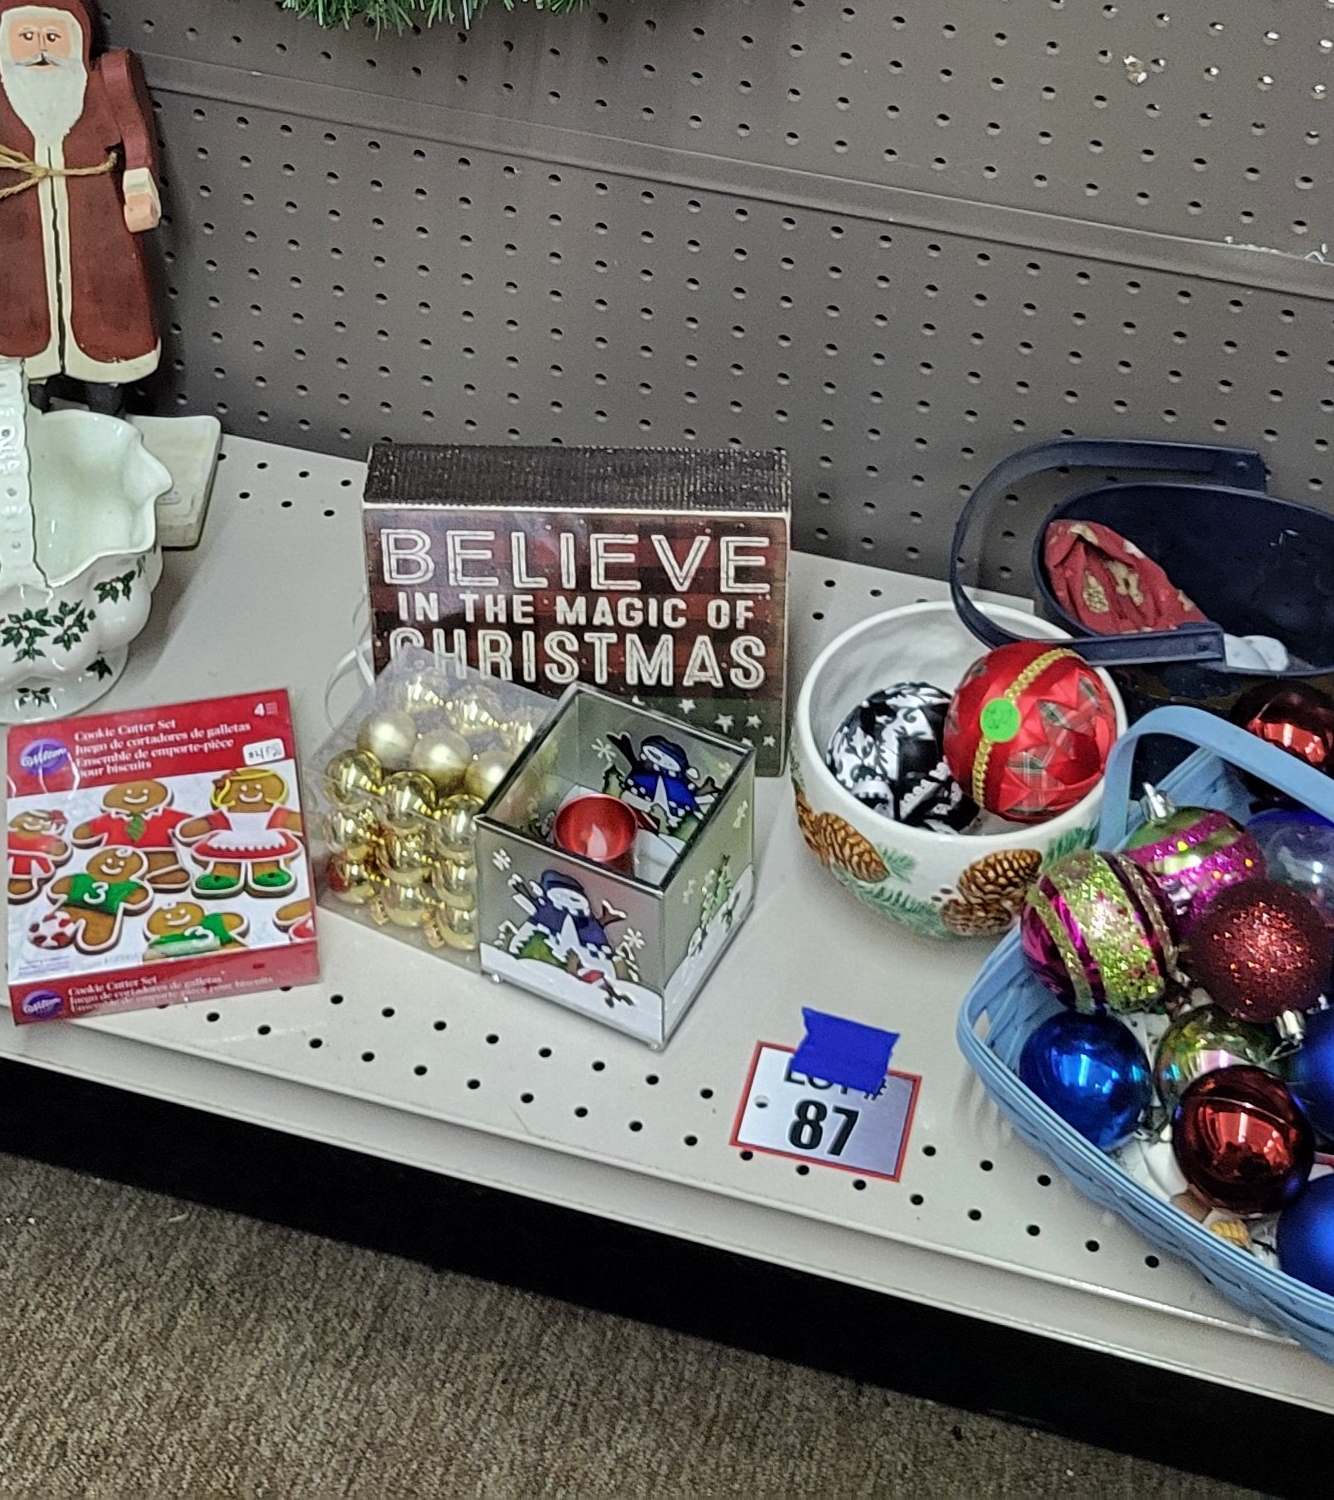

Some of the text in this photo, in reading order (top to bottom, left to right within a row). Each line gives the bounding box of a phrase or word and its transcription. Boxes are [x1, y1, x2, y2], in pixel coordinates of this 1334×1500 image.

[380, 528, 771, 594] BELIEVE
[398, 592, 755, 629] IN THE MAGIC OF
[389, 627, 767, 689] CHRISTMAS
[254, 702, 265, 717] 4
[74, 719, 176, 741] Cookie Cutter Set
[75, 723, 251, 756] Juego de cortadores de galletas
[76, 751, 132, 768] Ensemble
[134, 749, 149, 759] de
[106, 760, 153, 775] biscuits
[83, 882, 109, 904] 3
[68, 984, 104, 997] Cookie
[105, 980, 139, 992] Cutter
[788, 1099, 860, 1156] 87
